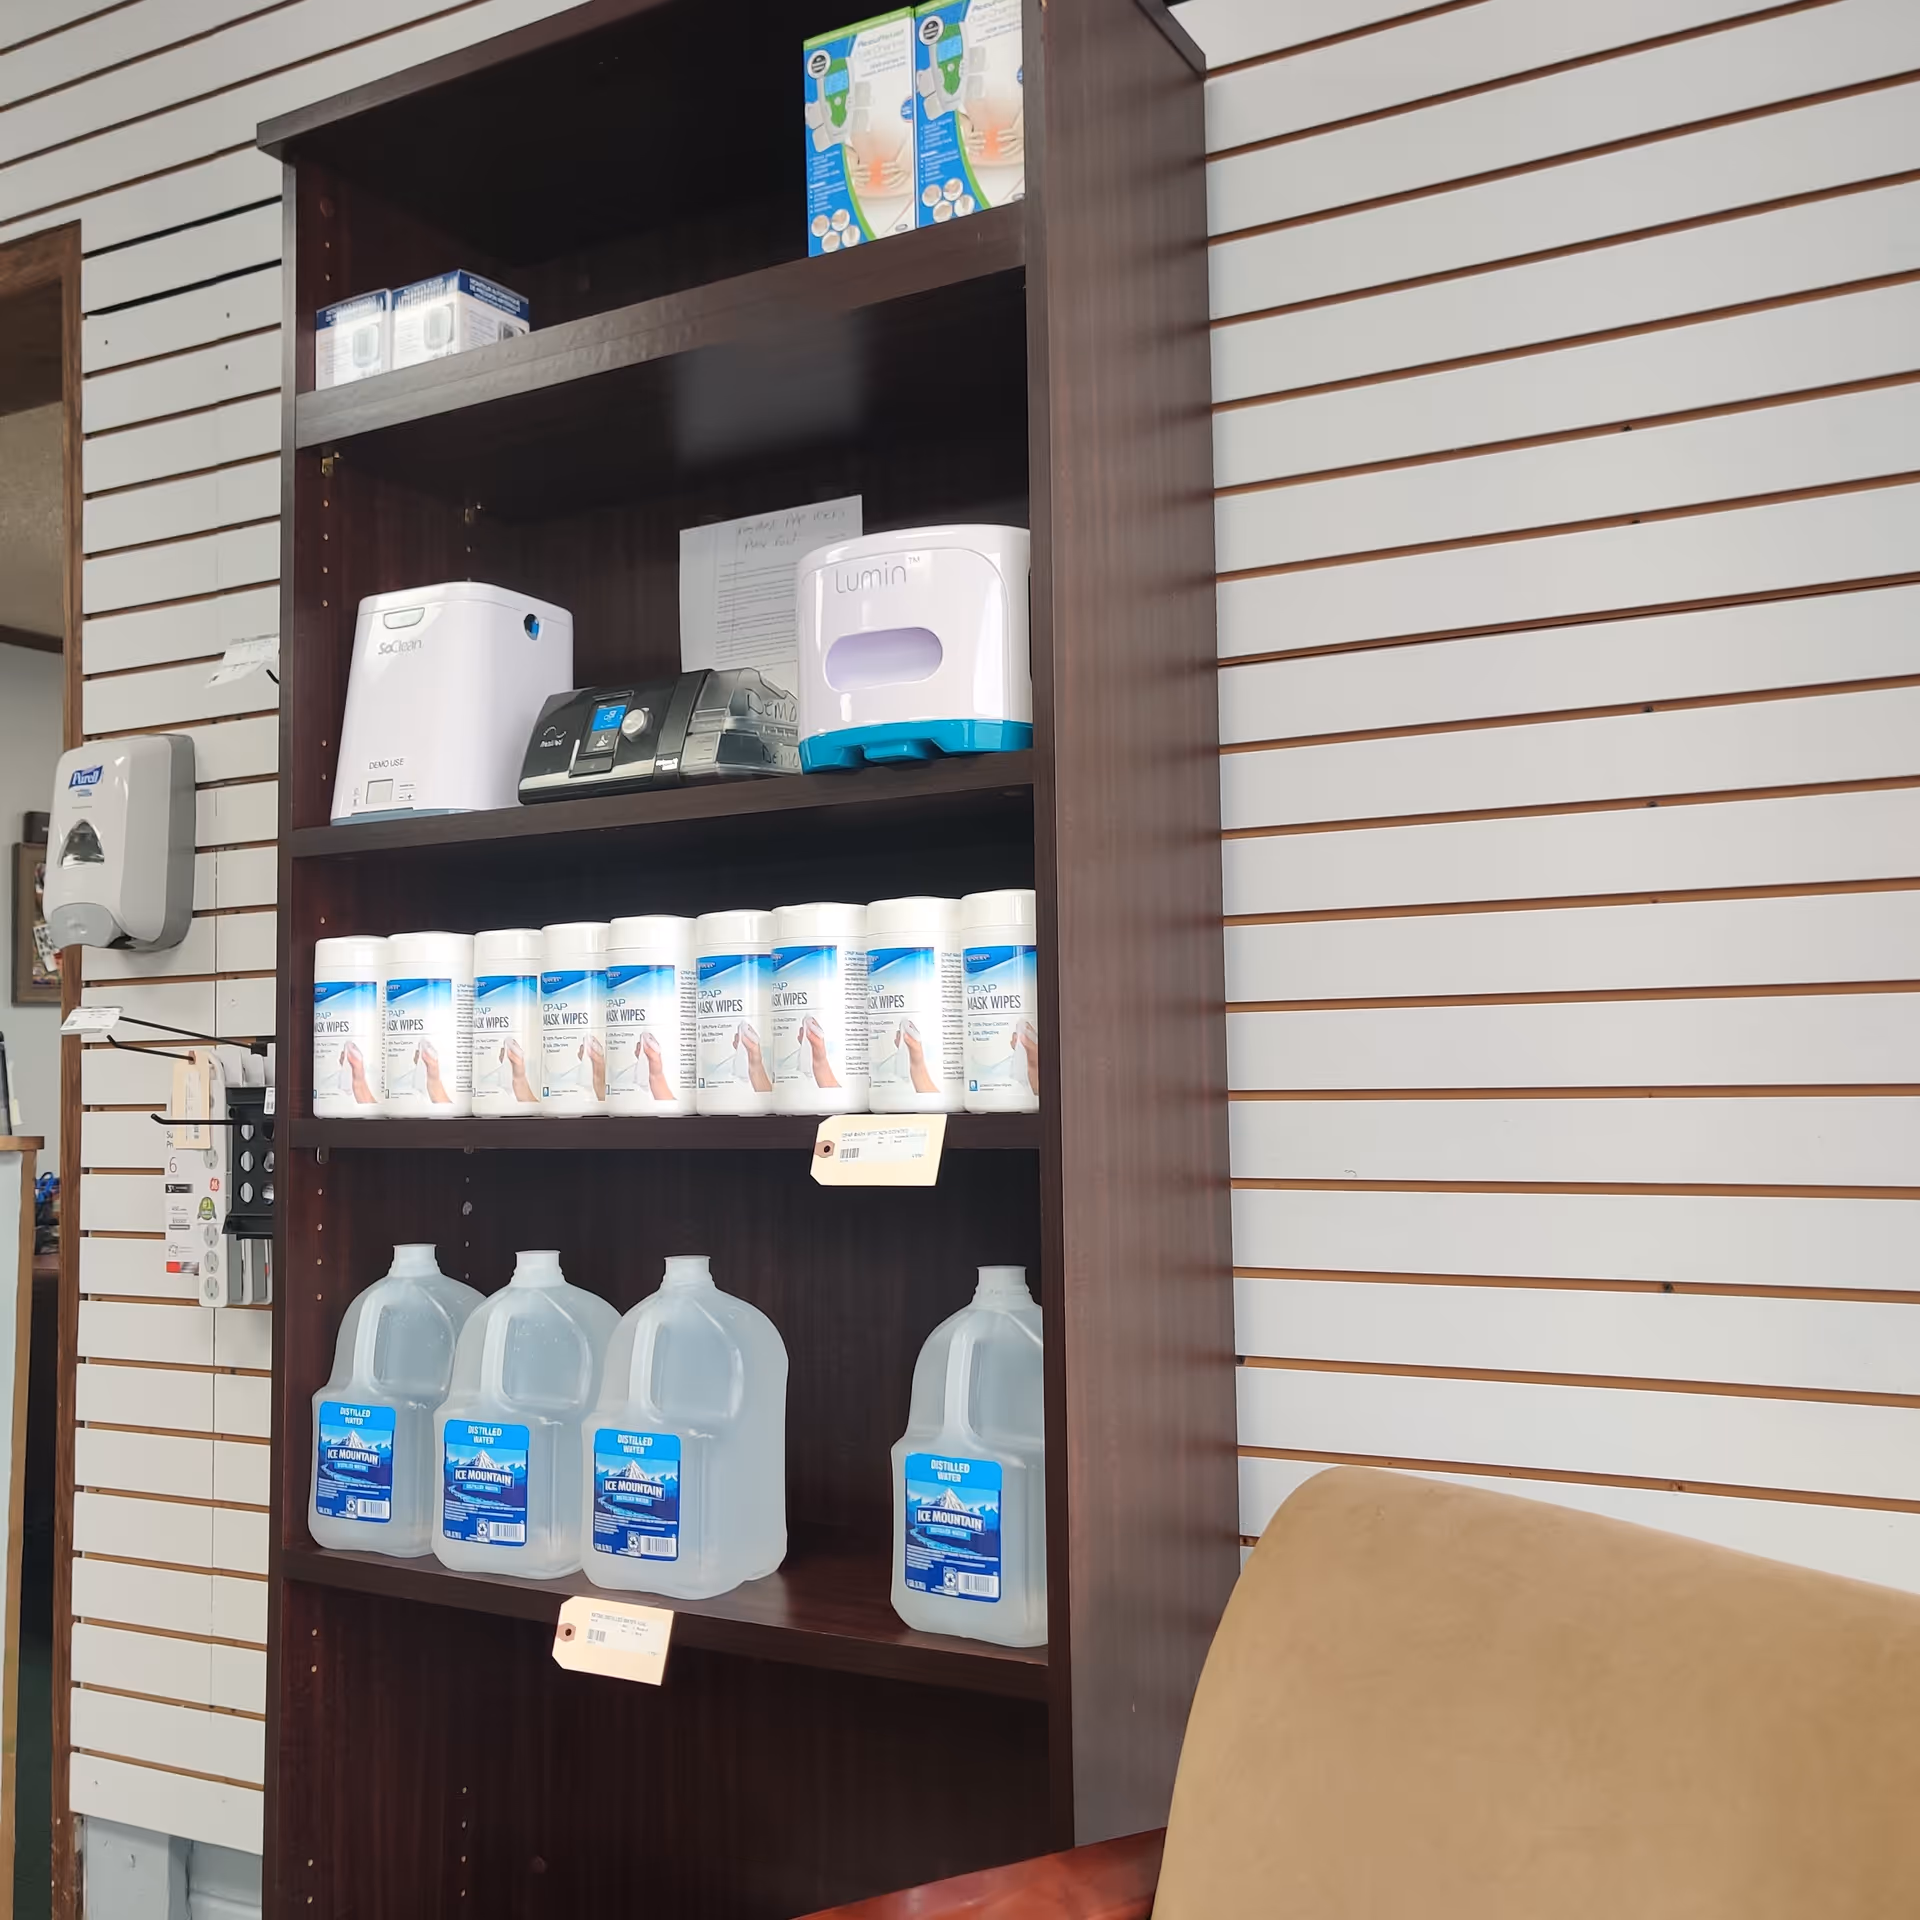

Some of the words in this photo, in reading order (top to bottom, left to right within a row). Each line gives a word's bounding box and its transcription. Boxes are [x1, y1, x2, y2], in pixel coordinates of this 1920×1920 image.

[836, 562, 906, 594] Lumin
[378, 638, 422, 654] SoClean
[368, 760, 390, 770] DEMO
[390, 758, 404, 767] USE
[72, 770, 100, 785] Purell
[698, 990, 722, 1000] CPAP
[967, 984, 997, 994] CPAP
[783, 992, 808, 1006] WIPES
[879, 994, 904, 1008] WIPES
[967, 996, 988, 1010] MASK
[990, 995, 1021, 1008] WIPES
[474, 1007, 491, 1016] PAP
[543, 1002, 568, 1012] CPAP
[716, 999, 743, 1012] WIPES
[316, 1012, 332, 1020] PAP
[388, 1010, 404, 1018] PAP
[562, 1012, 588, 1025] WIPES
[620, 1008, 646, 1022] WIPES
[326, 1020, 350, 1032] WIPES
[400, 1018, 424, 1030] WIPES
[486, 1016, 510, 1028] WIPES
[170, 1156, 177, 1173] 6
[340, 1406, 370, 1418] DISTILLED
[344, 1416, 364, 1426] WATER
[468, 1425, 502, 1436] DISTILLED
[473, 1436, 494, 1445] WATER
[617, 1434, 653, 1446] DISTILLED
[623, 1444, 645, 1455] WATER
[328, 1448, 338, 1460] ICE
[338, 1449, 379, 1466] MOUNTAIN
[930, 1459, 970, 1474] DISTILLED
[455, 1469, 467, 1480] ICE
[467, 1470, 512, 1486] MOUNTAIN
[937, 1471, 962, 1483] WATER
[605, 1480, 617, 1491] ICE
[618, 1481, 664, 1498] MOUNTAIN
[918, 1510, 931, 1522] ICE
[932, 1511, 983, 1531] MOUNTAIN
